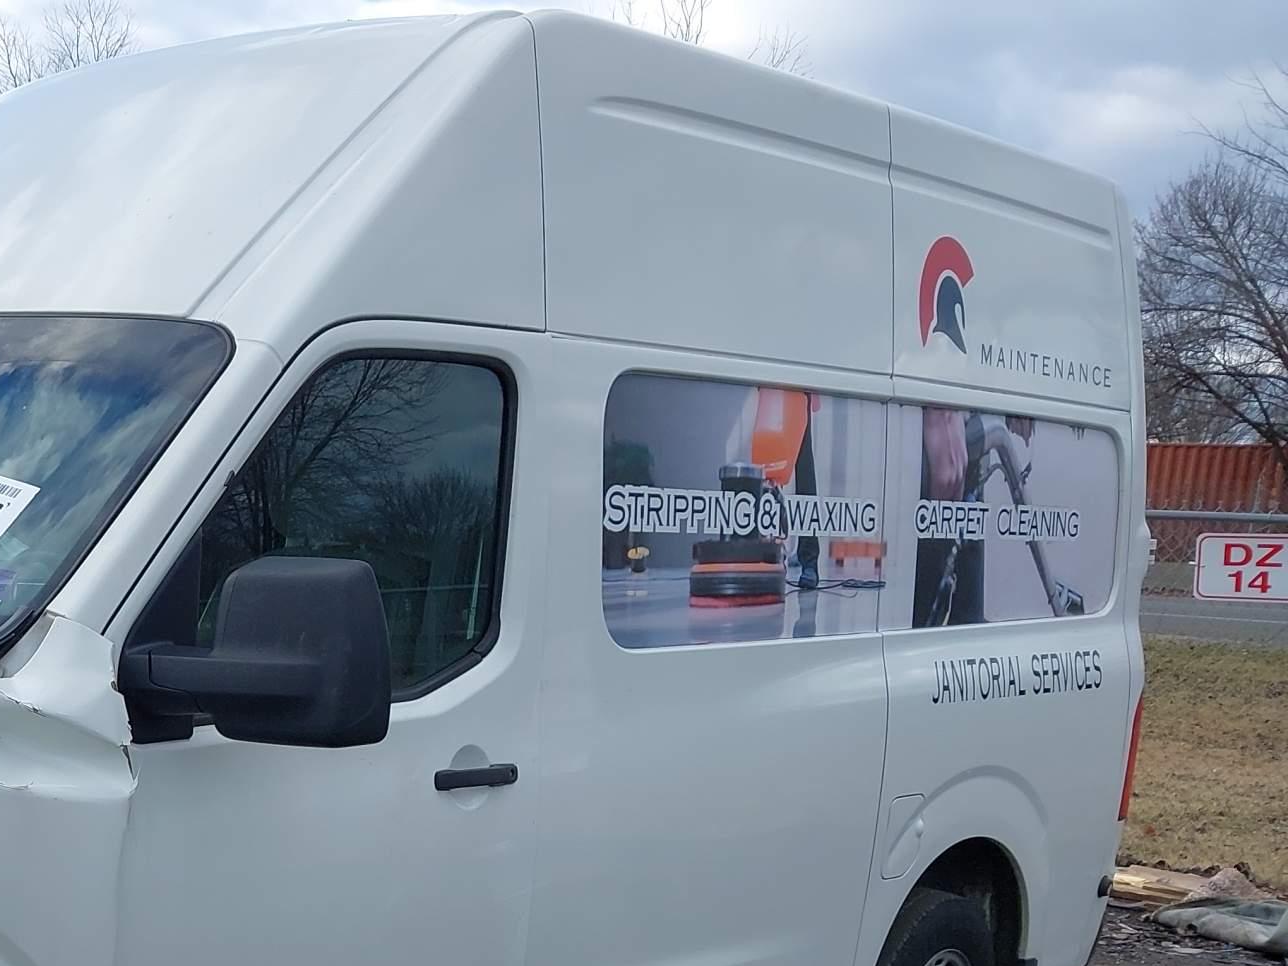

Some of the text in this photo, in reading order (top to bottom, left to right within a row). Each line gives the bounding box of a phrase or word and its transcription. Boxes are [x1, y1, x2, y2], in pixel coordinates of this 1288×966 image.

[980, 343, 1112, 388] MAINTENANCE
[607, 488, 876, 533] STRIPPING & WAXING
[915, 504, 1080, 538] CARPET CLEANING
[1223, 543, 1284, 567] DZ
[1227, 570, 1272, 593] 14
[932, 650, 1102, 704] JANITORIAL SERVICES
